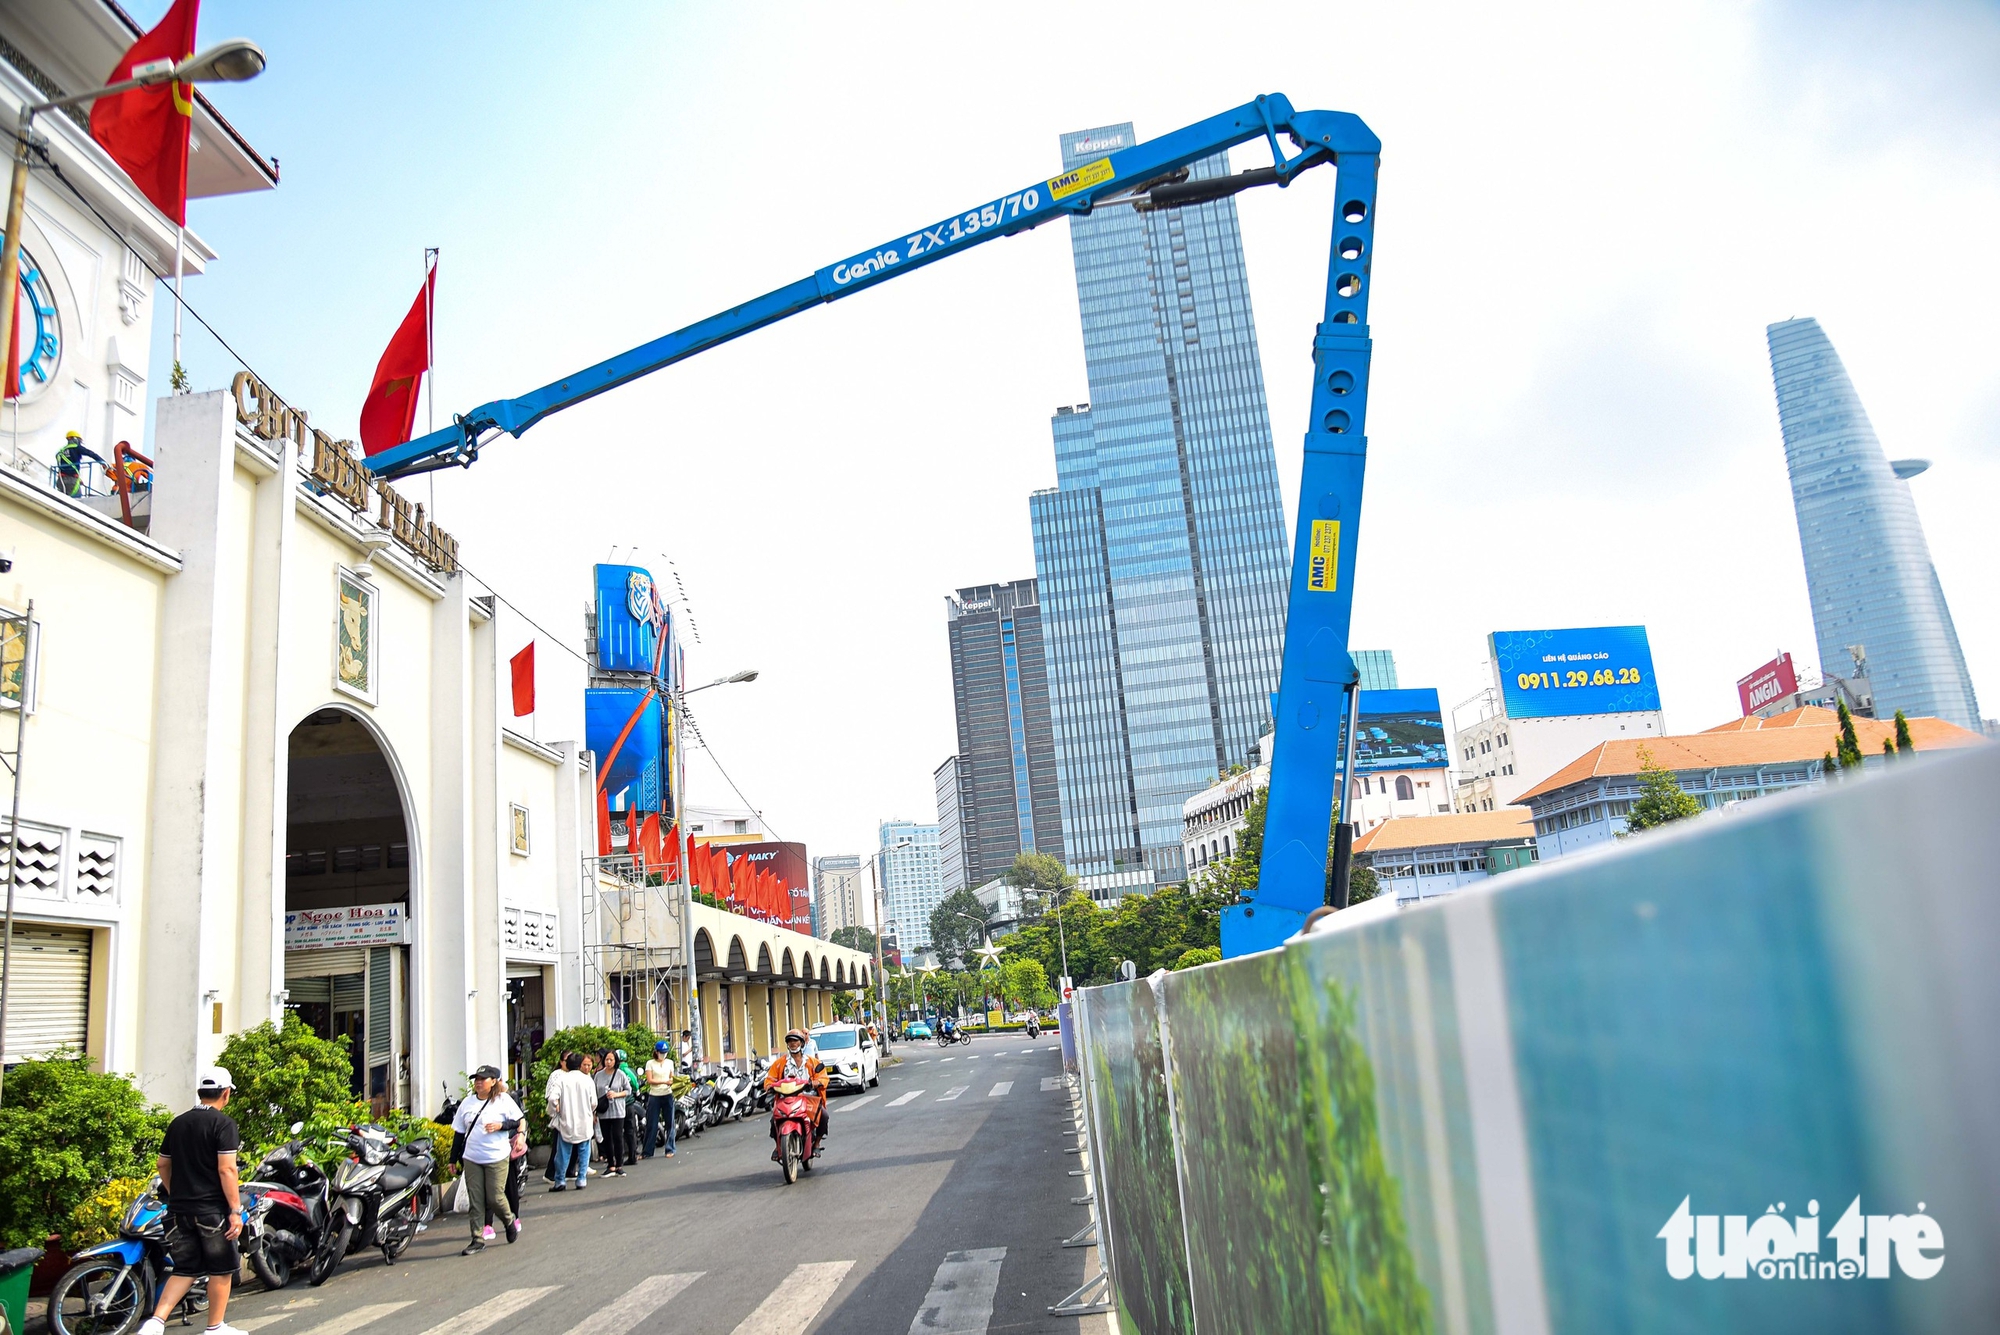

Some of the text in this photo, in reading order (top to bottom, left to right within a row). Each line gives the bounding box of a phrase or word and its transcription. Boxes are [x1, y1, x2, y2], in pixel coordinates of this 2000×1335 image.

[1075, 136, 1122, 152] Keppel
[1051, 173, 1080, 190] AMC
[832, 251, 900, 285] Genie
[1311, 556, 1325, 588] AMC
[962, 599, 991, 610] Keppel
[1542, 653, 1557, 662] LIÊN
[1557, 653, 1567, 663] HỆ
[1567, 651, 1593, 662] QUẢNG
[1517, 667, 1641, 690] 0911.29.68.28
[300, 911, 344, 925] Ngọc
[349, 906, 385, 920] Hoa
